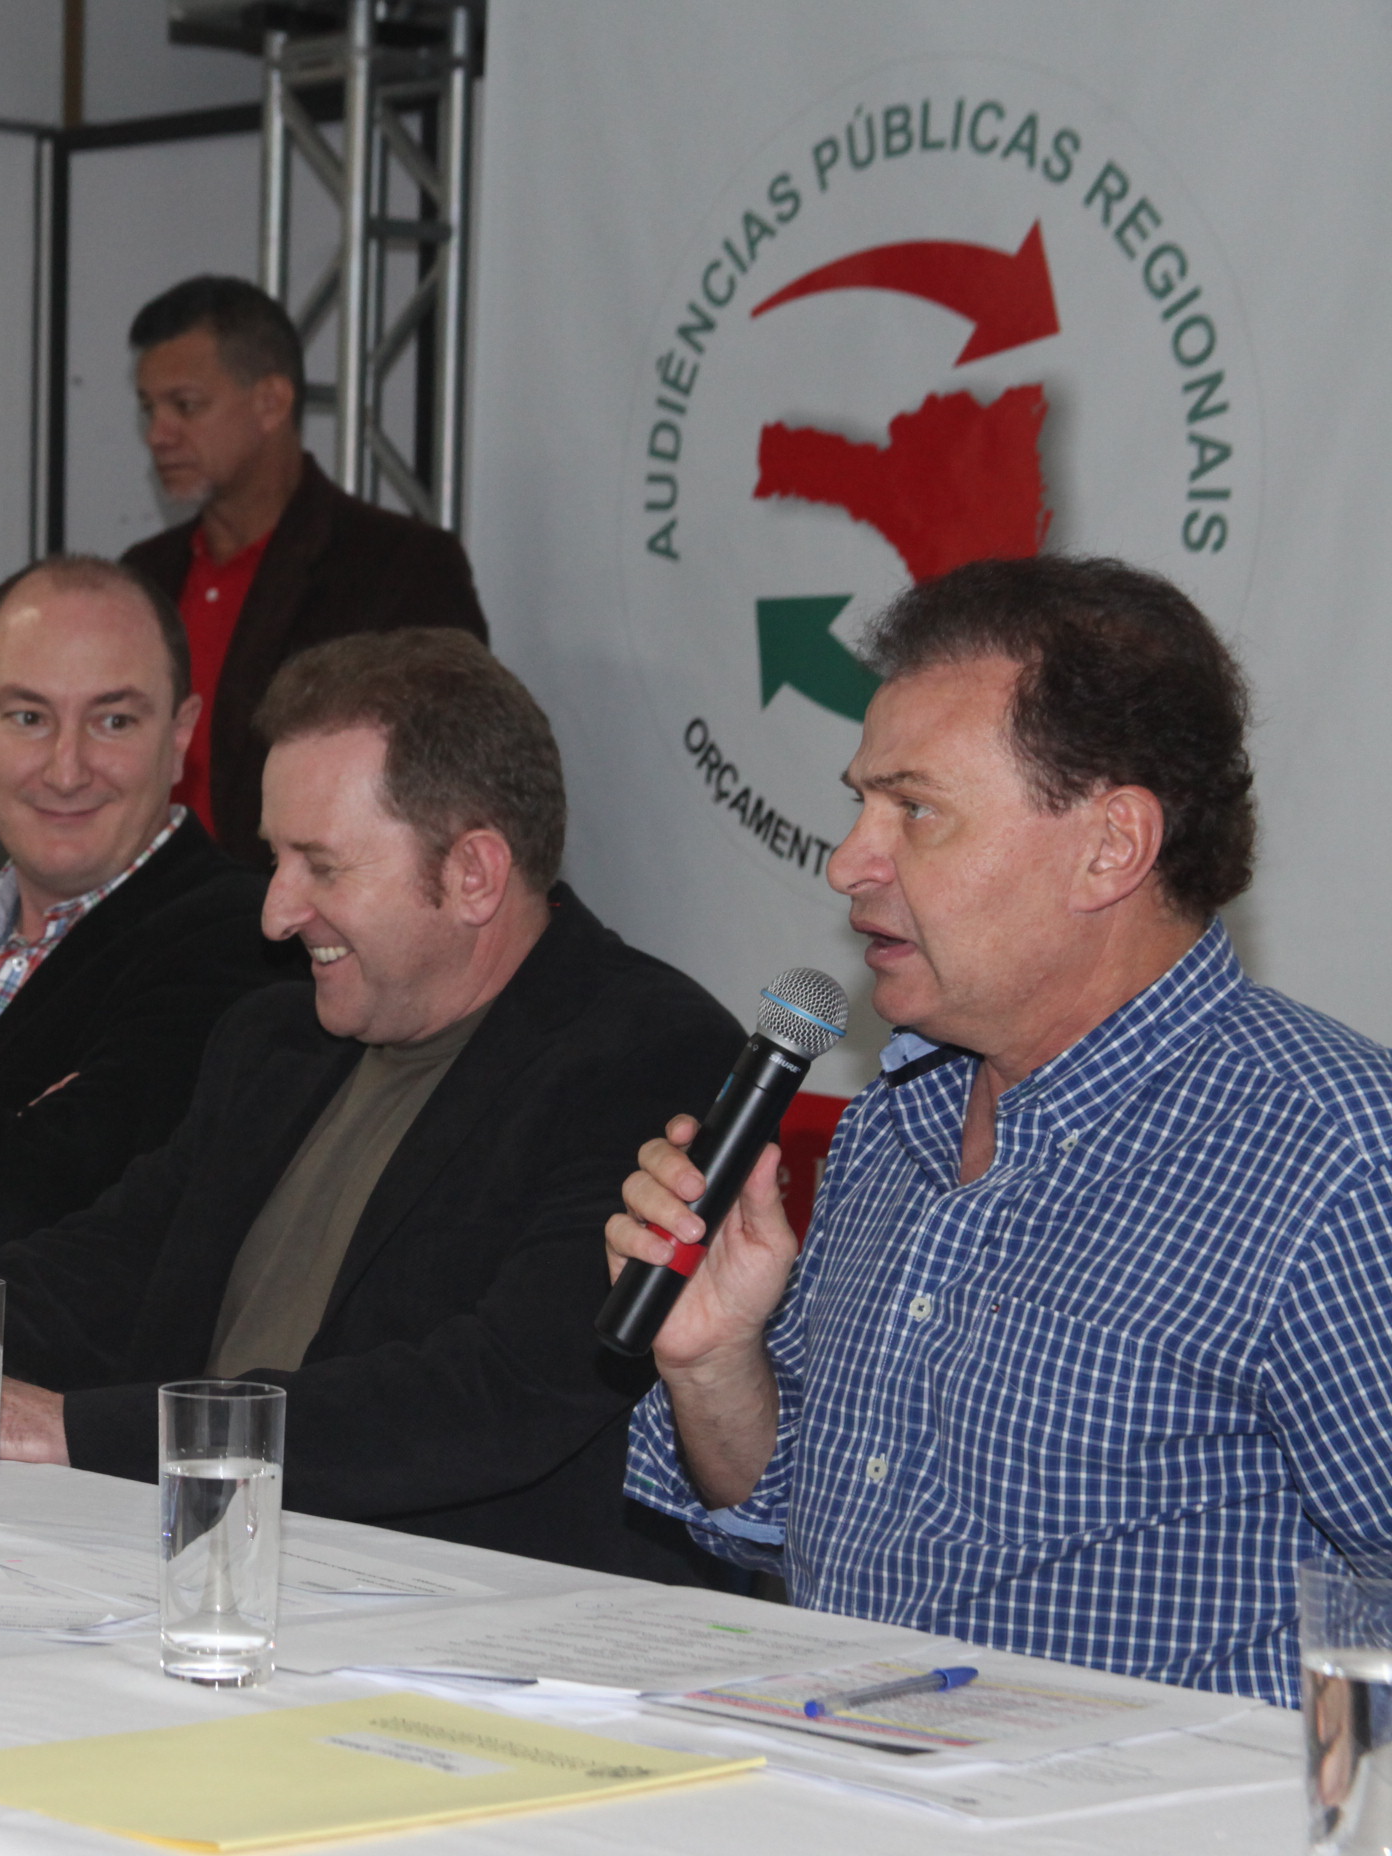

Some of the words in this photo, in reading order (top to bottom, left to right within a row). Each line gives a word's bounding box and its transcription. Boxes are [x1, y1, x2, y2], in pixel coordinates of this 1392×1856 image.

[644, 173, 802, 563] AUDIÊNCIAS
[812, 98, 1081, 190] PÚBLICAS
[1084, 162, 1233, 556] REGIONAIS
[683, 717, 838, 877] ORÇAMENT
